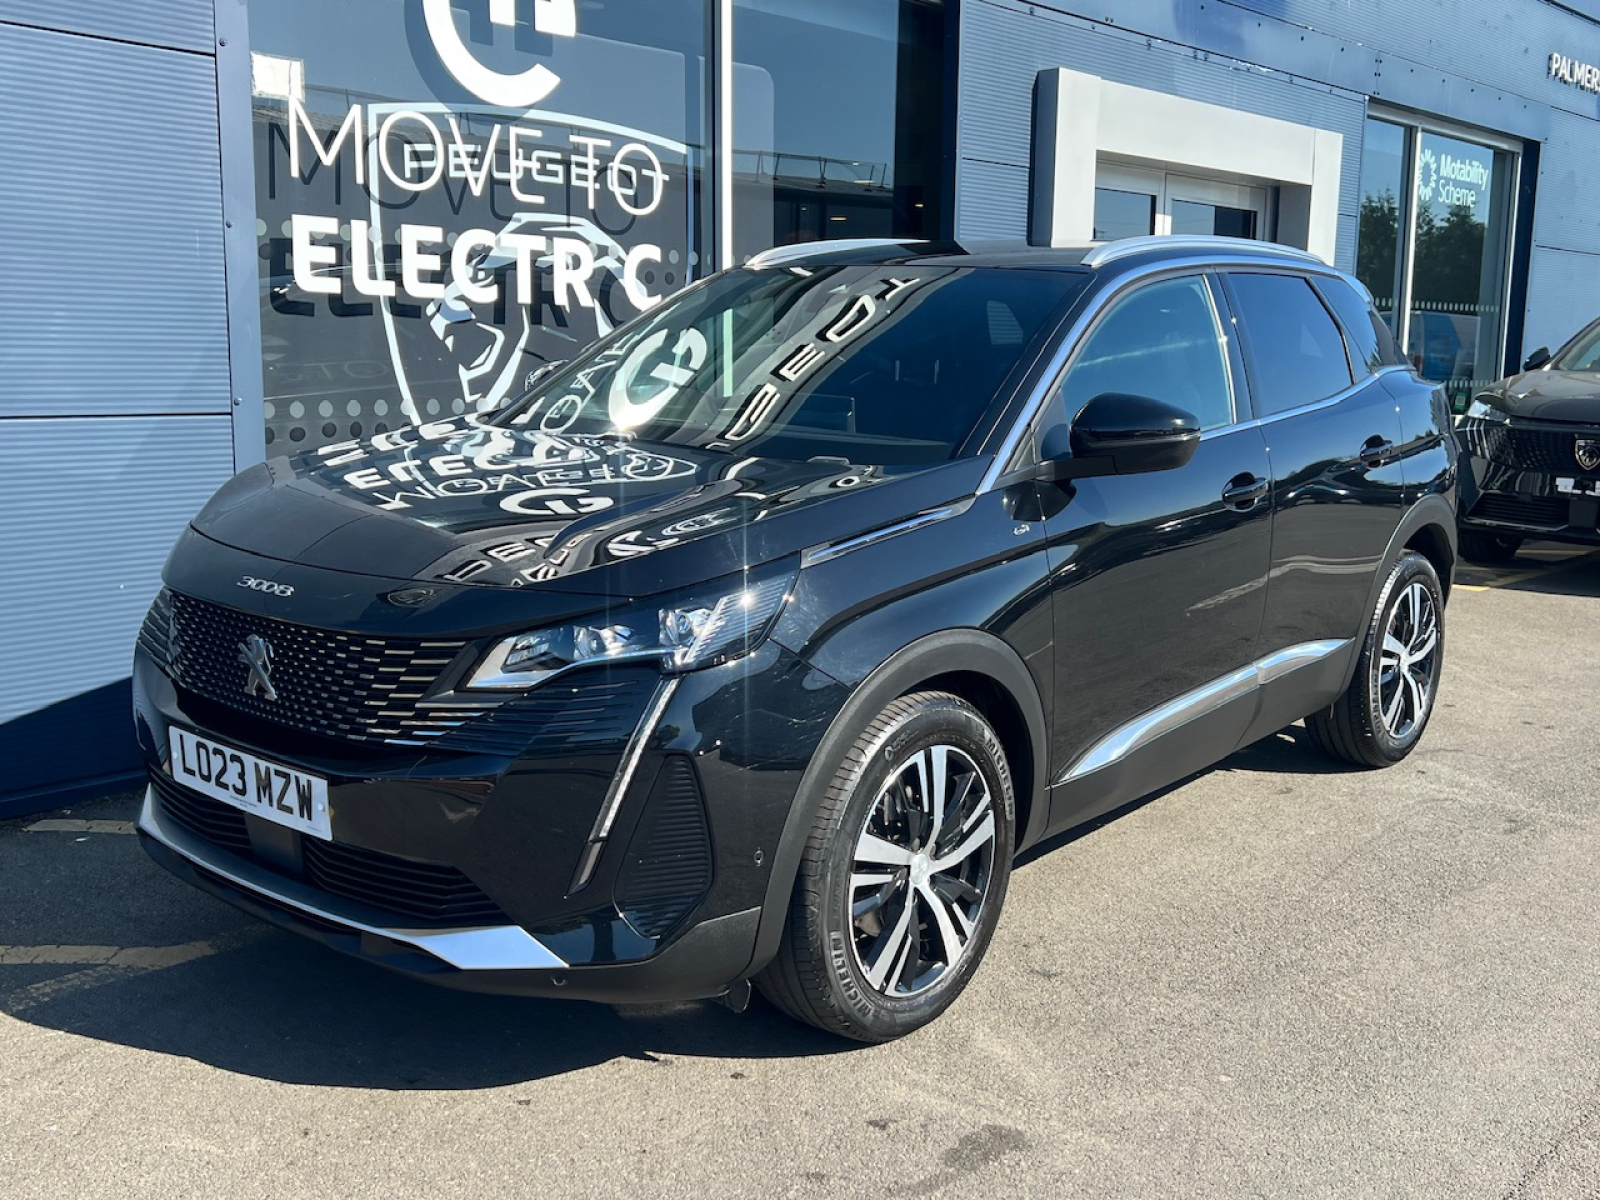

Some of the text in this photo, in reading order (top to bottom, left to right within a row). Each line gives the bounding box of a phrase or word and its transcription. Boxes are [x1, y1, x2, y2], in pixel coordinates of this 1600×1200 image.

[288, 98, 664, 216] MOVE TO
[1440, 154, 1489, 191] Motability
[1438, 179, 1476, 208] Scheme
[236, 575, 295, 597] 3008
[178, 733, 313, 822] LO23 MZW
[829, 931, 874, 1017] MICHELIN
